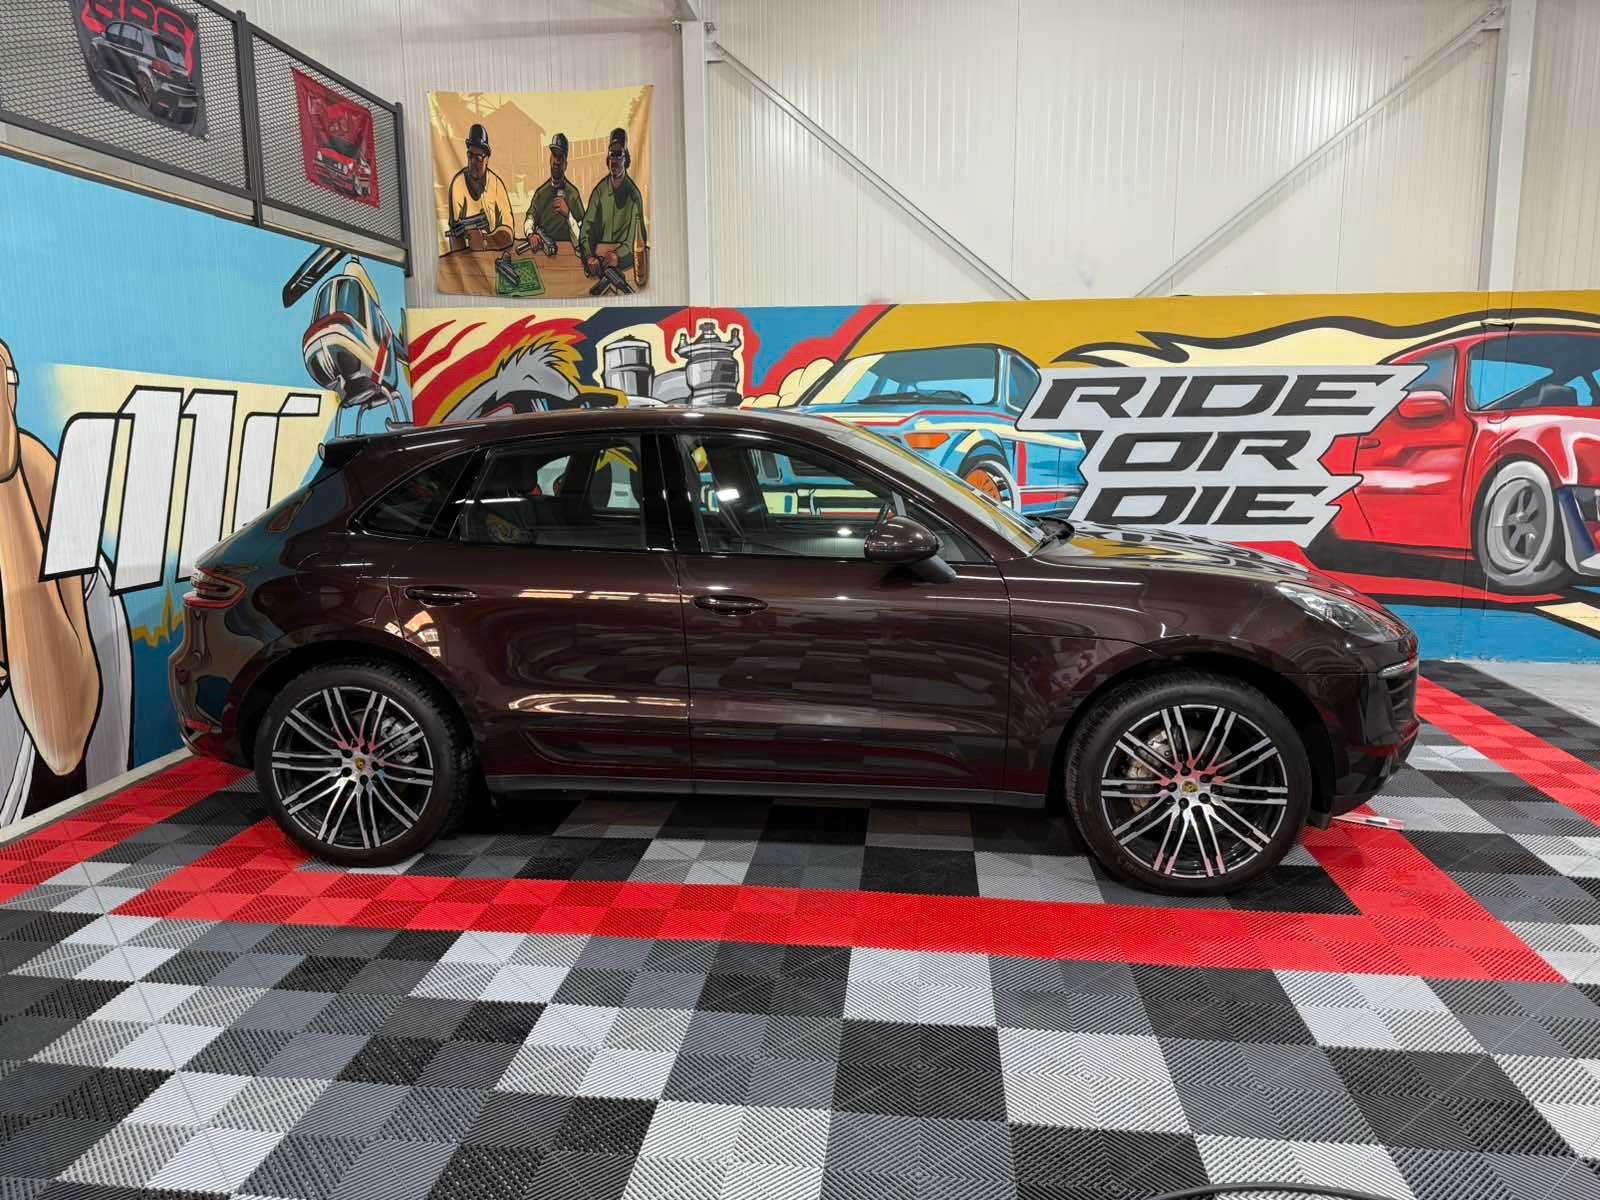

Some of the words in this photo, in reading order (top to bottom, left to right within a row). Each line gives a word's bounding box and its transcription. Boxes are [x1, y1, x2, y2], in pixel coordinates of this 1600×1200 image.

[1032, 375, 1394, 418] RIDE
[1099, 431, 1311, 472] OR
[1084, 487, 1326, 525] DIE
